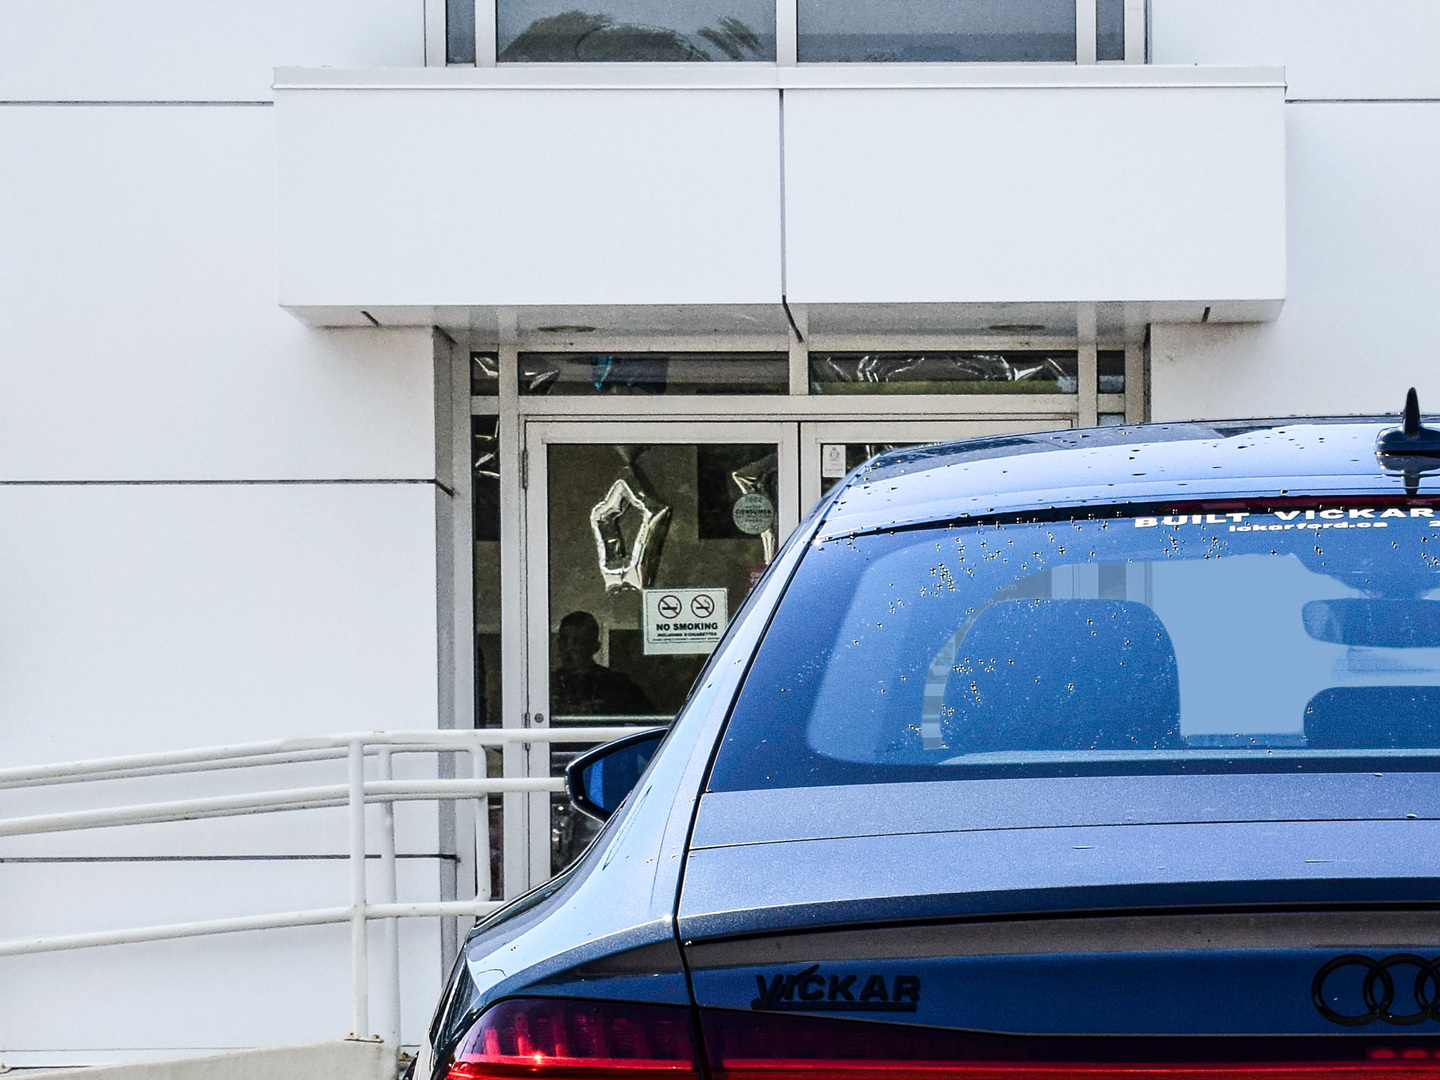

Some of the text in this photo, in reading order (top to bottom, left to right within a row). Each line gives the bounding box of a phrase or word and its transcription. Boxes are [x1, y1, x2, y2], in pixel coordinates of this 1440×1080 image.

[1134, 512, 1251, 528] BUILT
[1273, 507, 1435, 521] VICKAR
[656, 622, 719, 632] NO SMOKING
[754, 966, 921, 1003] VICKAR
